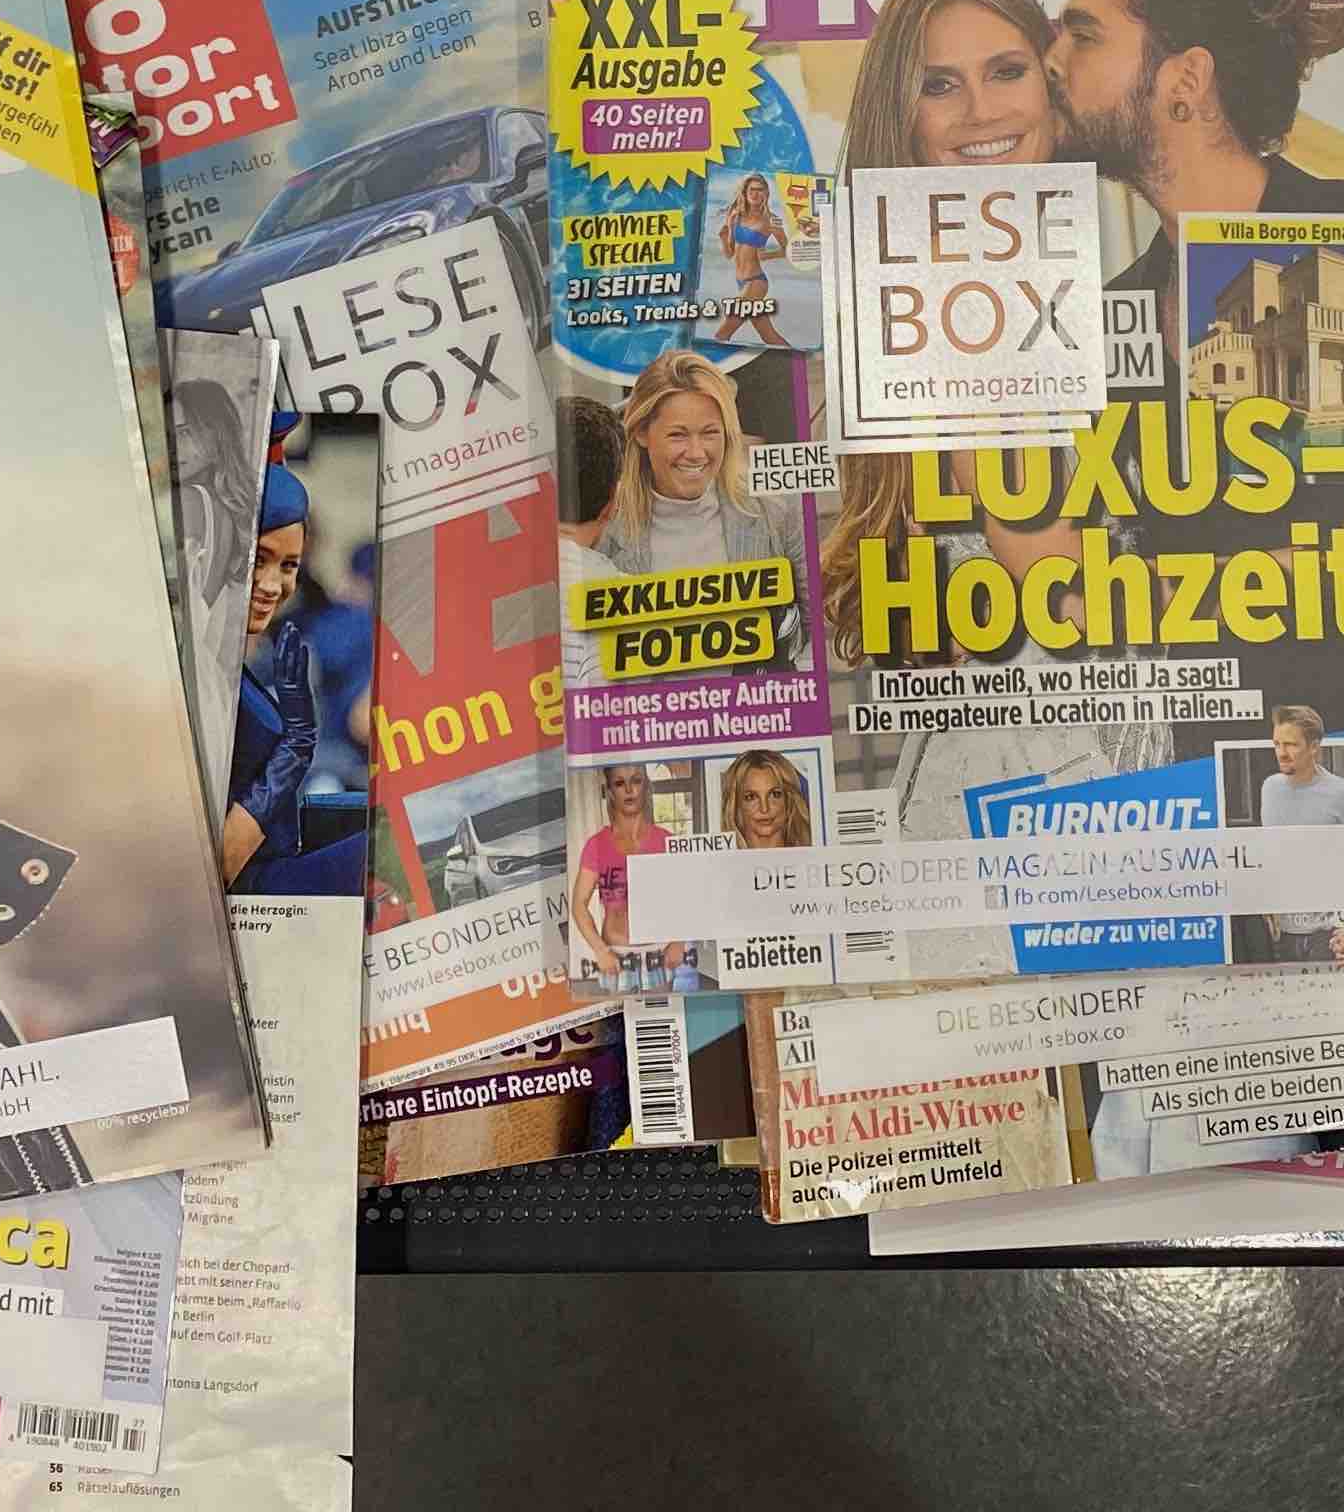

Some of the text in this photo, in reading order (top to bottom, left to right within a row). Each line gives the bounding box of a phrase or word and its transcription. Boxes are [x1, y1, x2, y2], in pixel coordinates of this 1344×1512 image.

[11, 45, 52, 76] dir
[570, 51, 725, 95] Ausgabe
[590, 104, 704, 127] 40 Seiten
[612, 127, 683, 151] mehr!
[876, 190, 1078, 265] LESE
[1220, 222, 1253, 240] Villa
[1258, 222, 1306, 241] Borgo
[882, 279, 1079, 356] BOX
[883, 373, 1087, 400] rent magazines
[754, 446, 831, 468] HELENE
[752, 468, 835, 491] FISCHER
[586, 567, 779, 620] EXKLUSIVE
[615, 616, 760, 671] FOTOS
[878, 661, 1233, 697] InTouch weiß, wo Heidi Ja sagt!
[855, 707, 892, 732] Die
[900, 704, 1022, 732] megateure
[1030, 698, 1125, 724] Location
[1133, 697, 1153, 721] in
[422, 1067, 593, 1112] Eintopf-Rezepte
[1206, 1116, 1249, 1138] kam
[1255, 1114, 1278, 1131] es
[1284, 1111, 1309, 1128] zu
[790, 1138, 983, 1178] Die Polizei ermittelt
